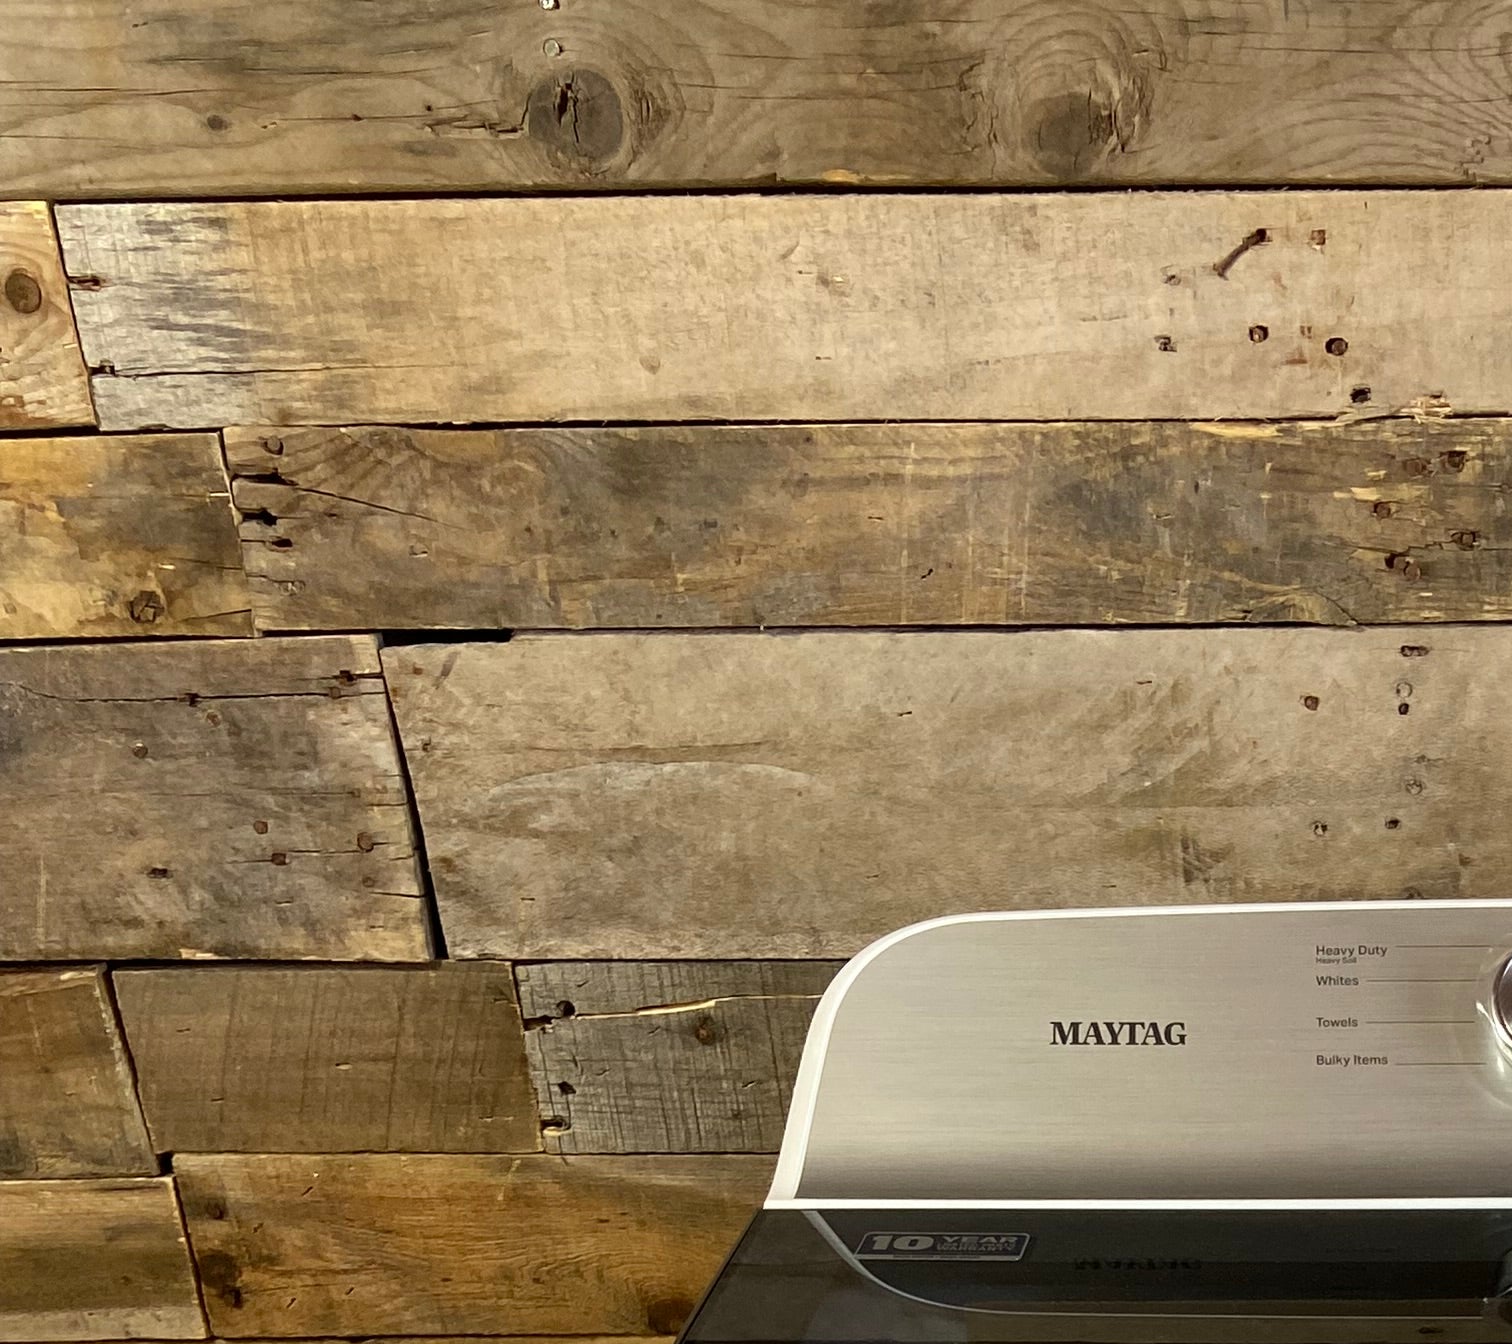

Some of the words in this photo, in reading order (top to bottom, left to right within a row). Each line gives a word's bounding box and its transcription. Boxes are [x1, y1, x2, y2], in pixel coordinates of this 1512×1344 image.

[1316, 945, 1354, 957] Heavy
[1358, 945, 1387, 957] Duty
[1316, 975, 1359, 986] Whites
[1316, 1016, 1358, 1027] Towels
[1050, 1021, 1187, 1046] MAYTAG
[1316, 1055, 1350, 1067] Bulky
[1354, 1055, 1388, 1065] Items
[871, 1235, 935, 1250] 10
